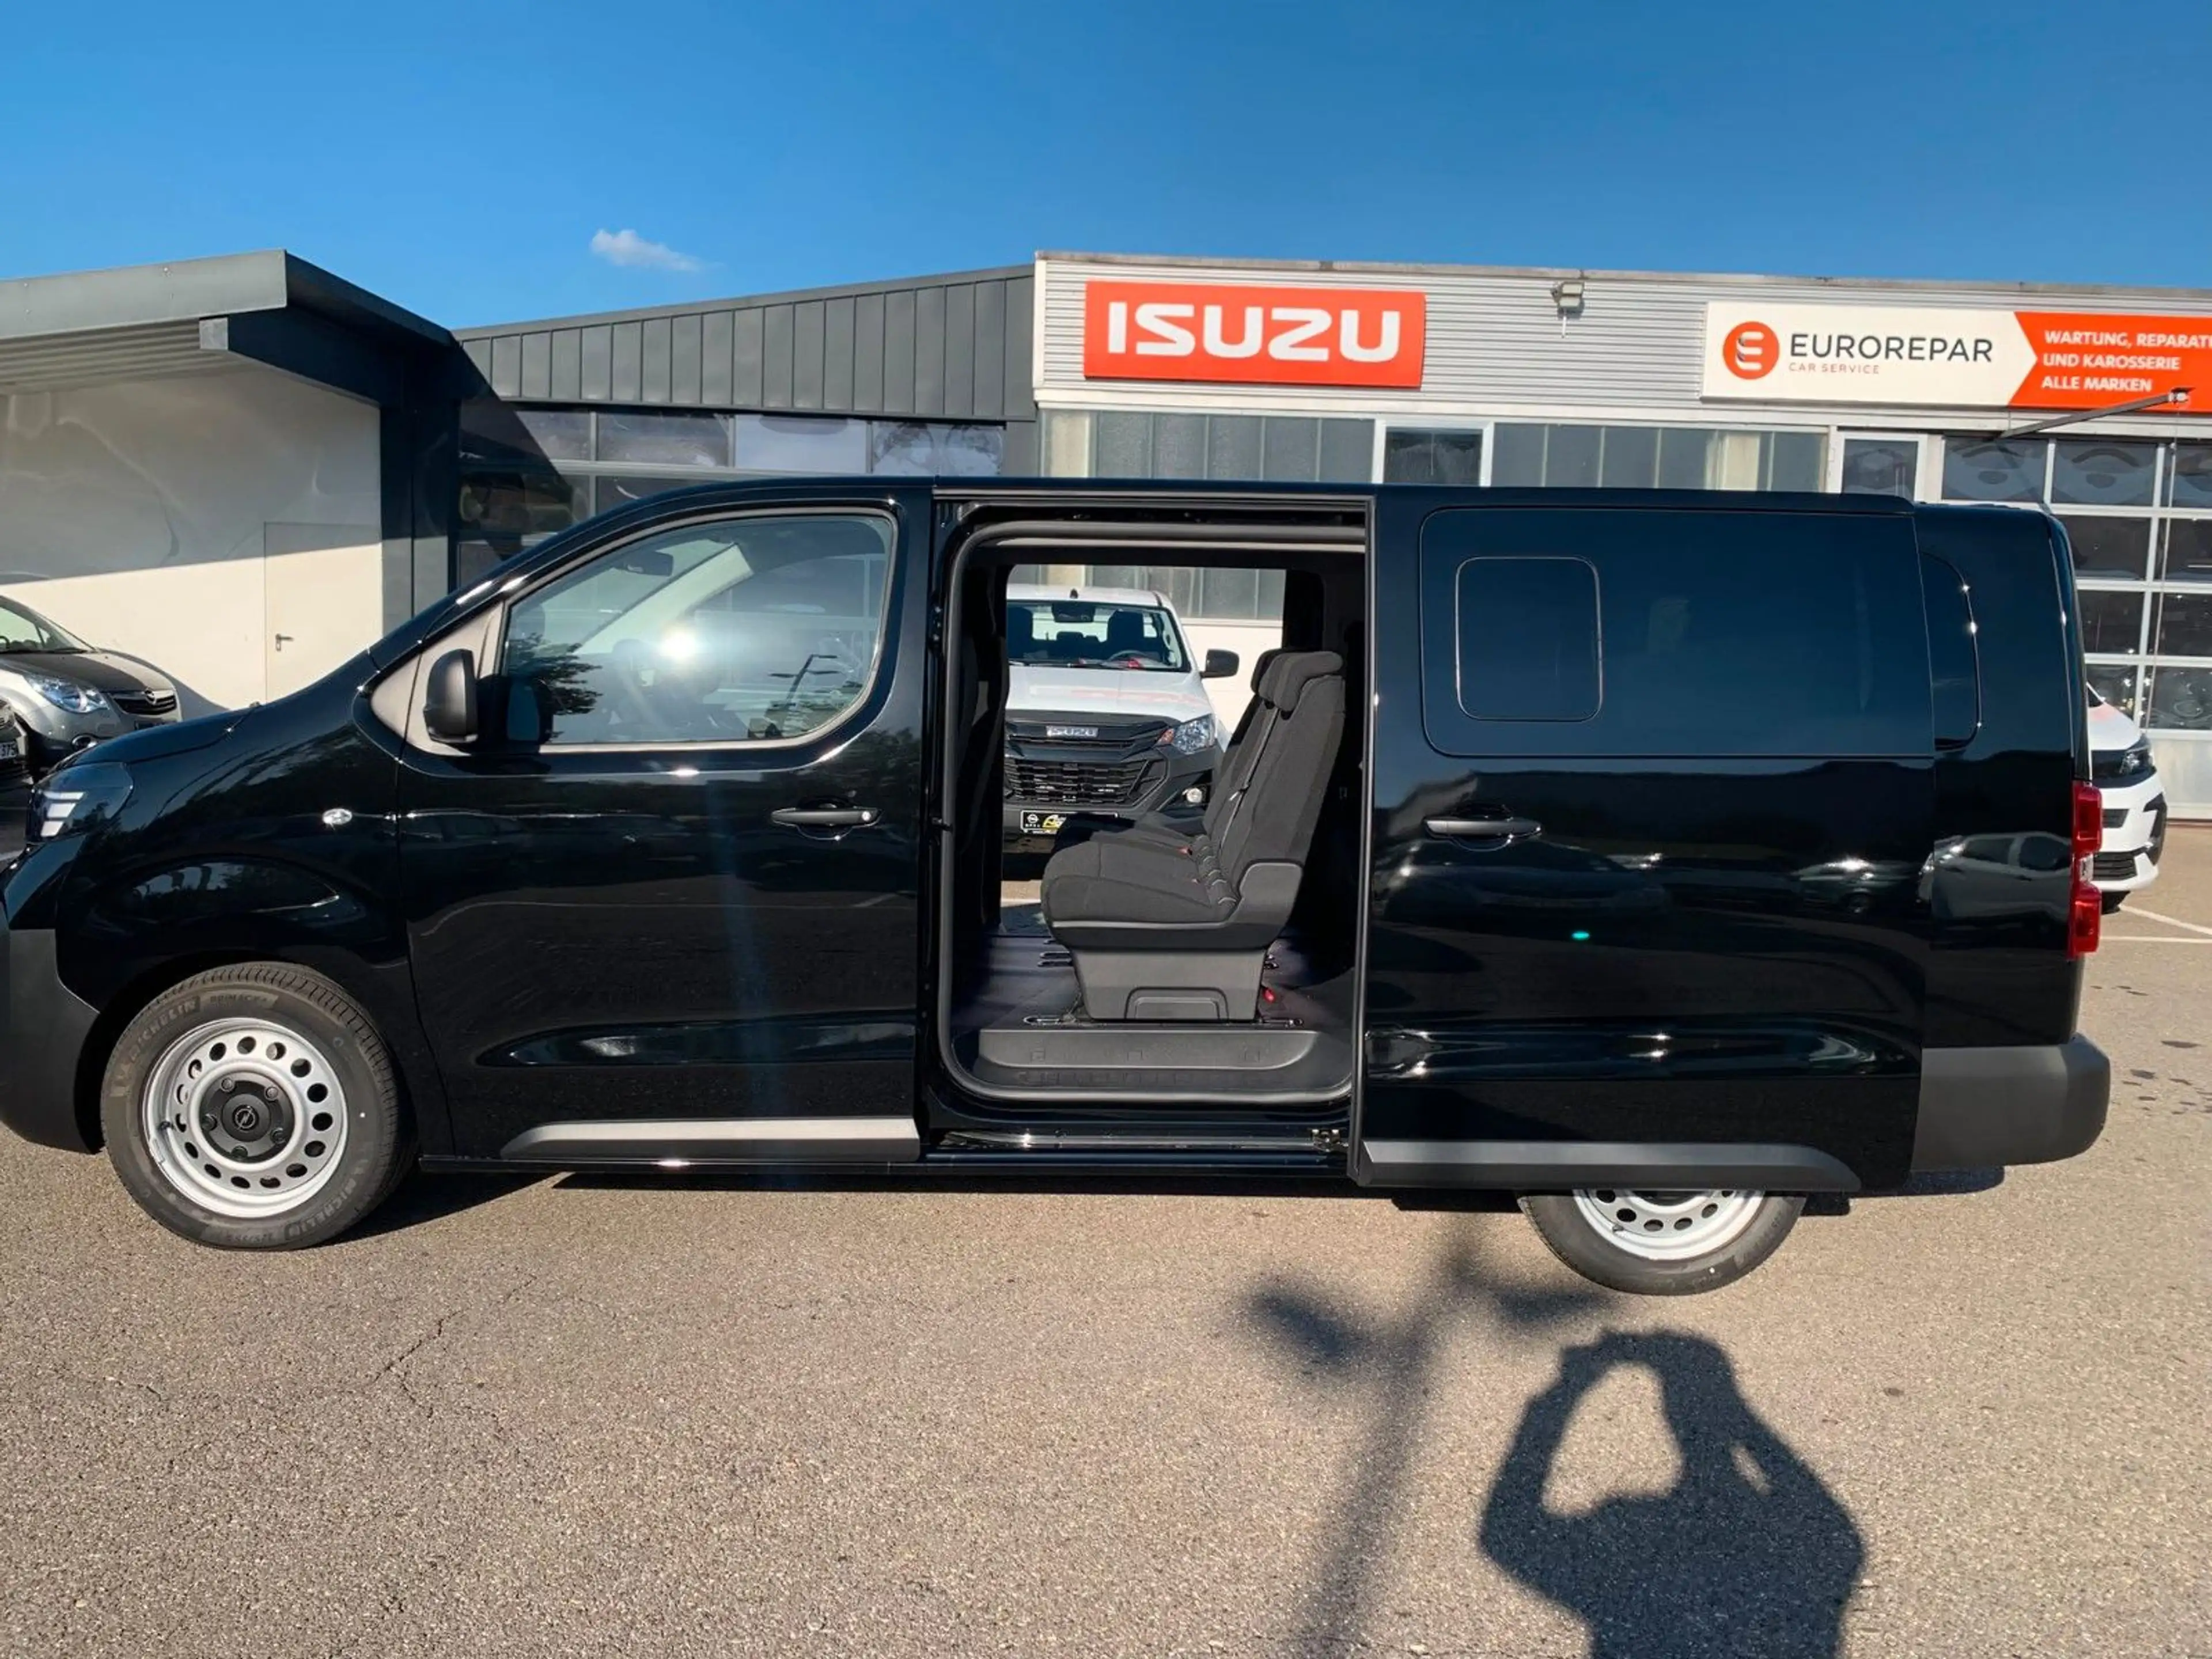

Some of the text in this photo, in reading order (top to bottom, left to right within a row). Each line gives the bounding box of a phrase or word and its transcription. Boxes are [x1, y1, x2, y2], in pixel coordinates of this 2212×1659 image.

[1108, 301, 1400, 362] ISUZU
[2044, 330, 2131, 349] WARTUNG,
[1790, 334, 1993, 362] EUROREPAR
[1789, 362, 1879, 374] CAR SERVICE
[2043, 353, 2180, 370] UND KAROSSERIE
[2041, 376, 2152, 392] ALLE MARKEN
